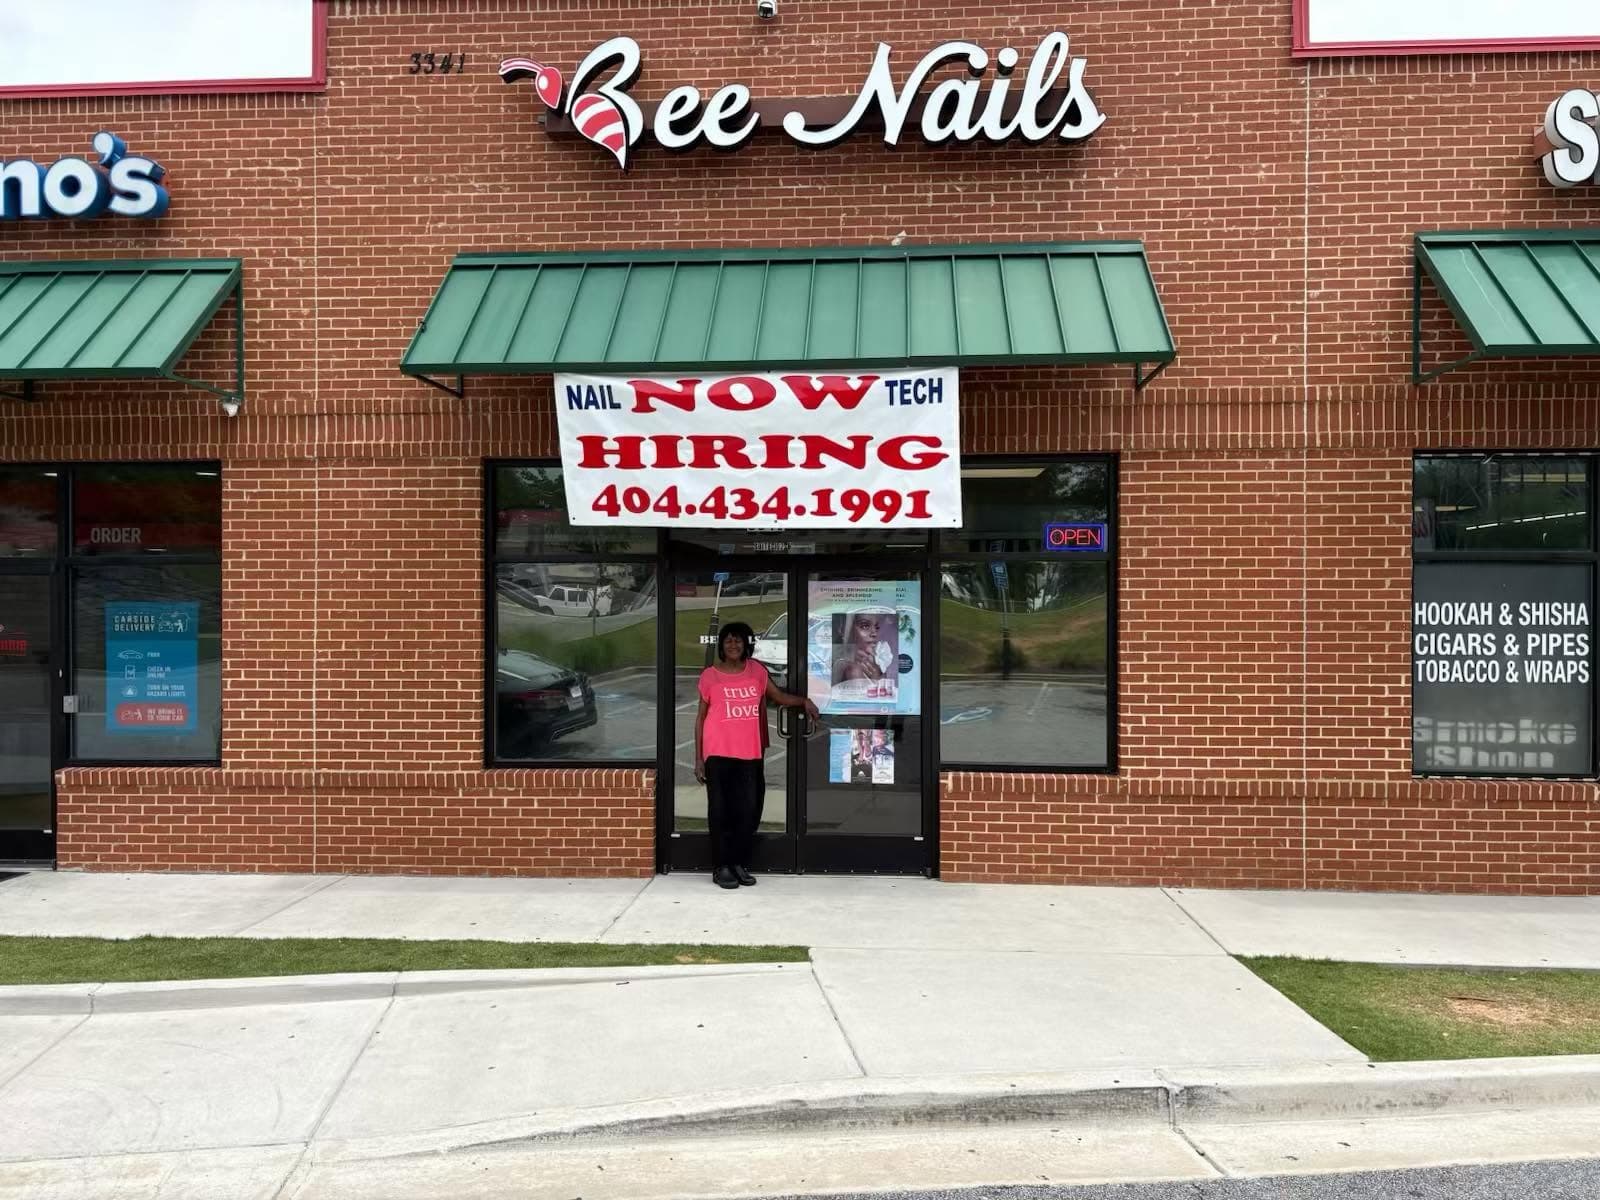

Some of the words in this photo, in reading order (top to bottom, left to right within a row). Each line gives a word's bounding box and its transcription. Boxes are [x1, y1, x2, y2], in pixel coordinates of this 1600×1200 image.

[409, 52, 465, 74] 3341
[565, 35, 761, 160] Bee
[782, 30, 1107, 146] Nails
[1544, 87, 1600, 187] S
[566, 384, 622, 410] NAIL
[626, 375, 881, 413] NOW
[884, 377, 943, 406] TECH
[576, 434, 950, 470] HIRING
[592, 483, 933, 523] 404.434.1991
[91, 527, 141, 544] ORDER
[1050, 529, 1101, 545] OPEN
[114, 615, 156, 624] CARSIDE
[1414, 602, 1493, 626] HOOKAH
[1499, 602, 1513, 626] &
[1518, 602, 1590, 626] SHISHA
[114, 624, 156, 632] DELIVERY
[1415, 633, 1497, 656] CIGARS
[1503, 633, 1520, 656] &
[1527, 633, 1590, 656] PIPES
[1416, 660, 1500, 683] TOBACCO
[1505, 660, 1519, 683] &
[1524, 660, 1590, 684] WRAPS
[723, 686, 758, 698] true
[726, 701, 760, 719] love
